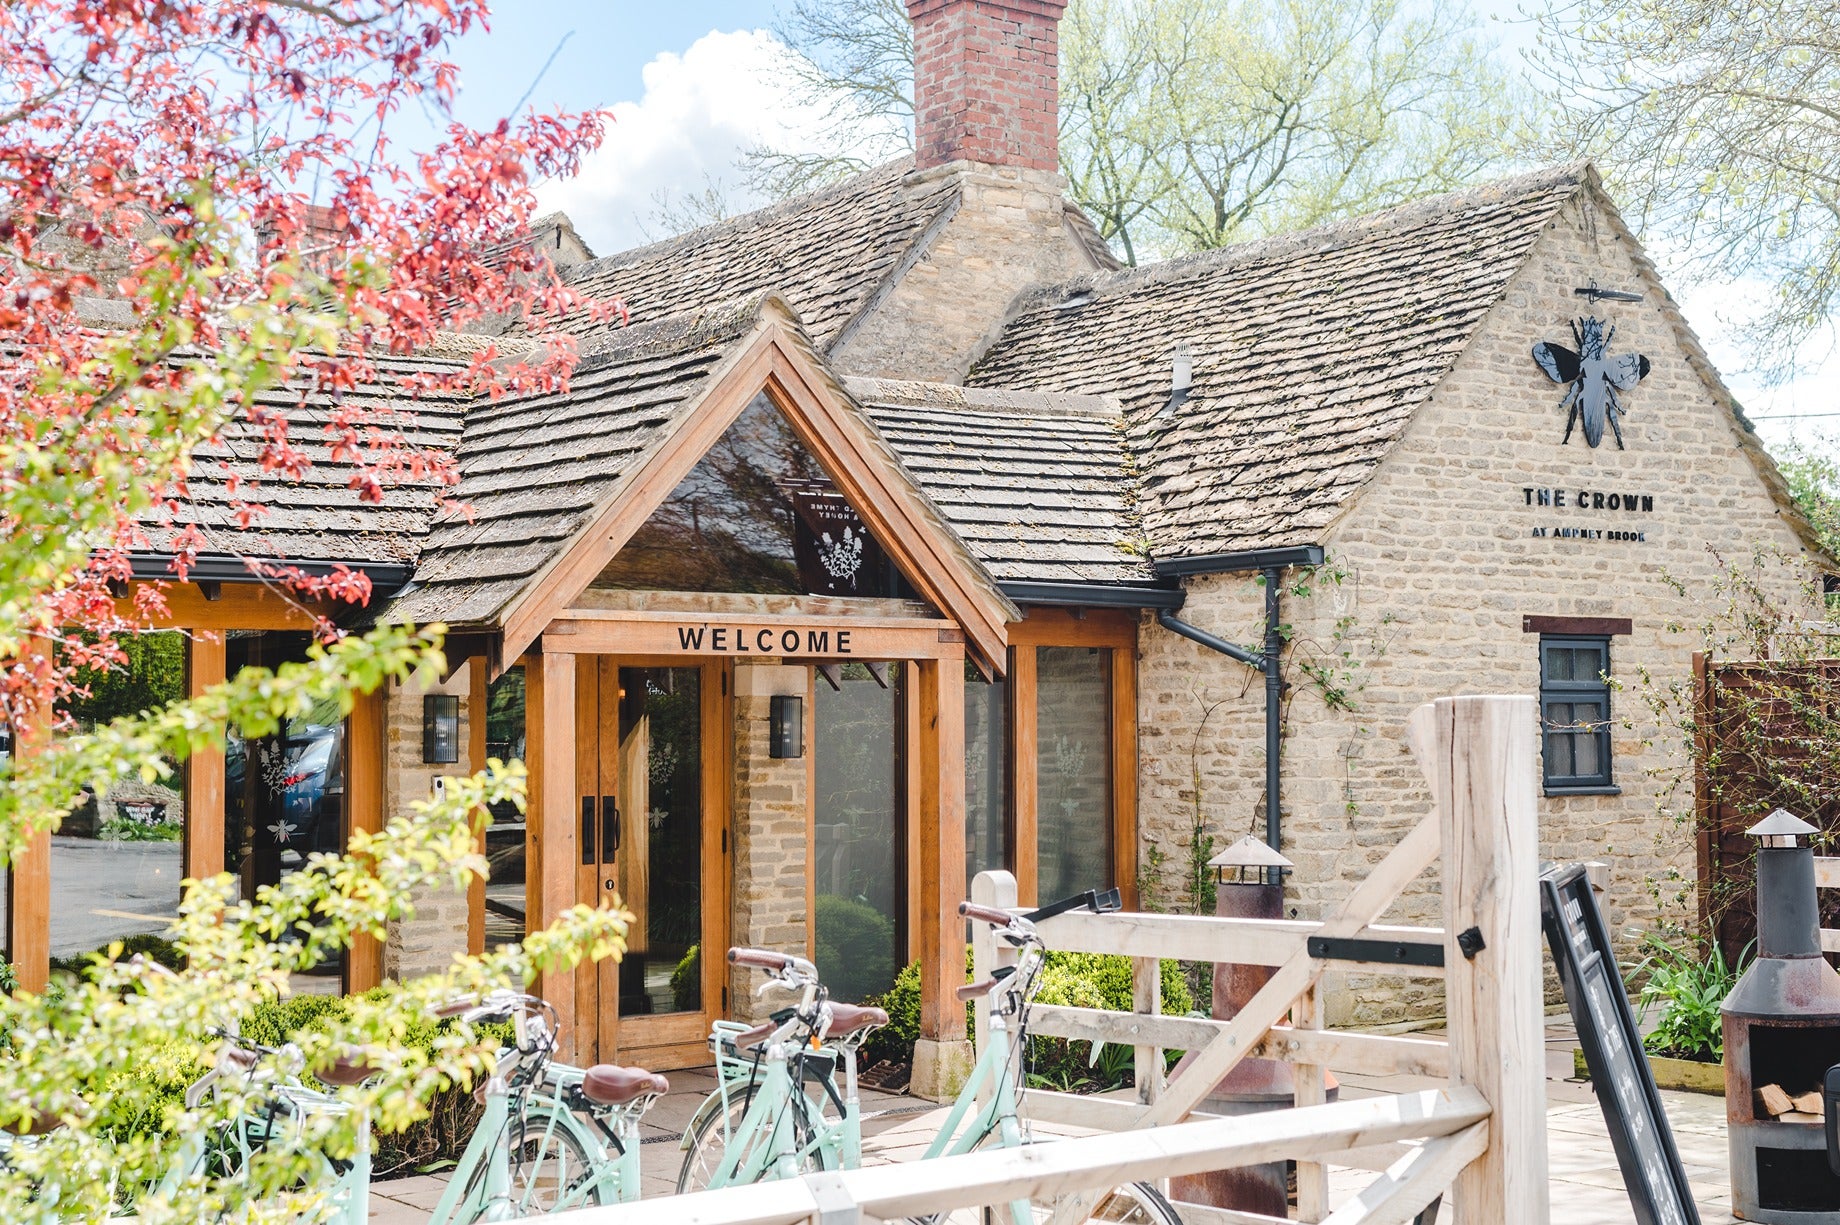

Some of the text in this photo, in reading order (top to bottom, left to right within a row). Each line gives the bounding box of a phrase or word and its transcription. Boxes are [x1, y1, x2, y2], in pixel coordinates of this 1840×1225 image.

[1523, 488, 1653, 512] THE CROWN
[1532, 527, 1645, 542] AT AMPNEY BROOK
[678, 627, 851, 653] WELCOME
